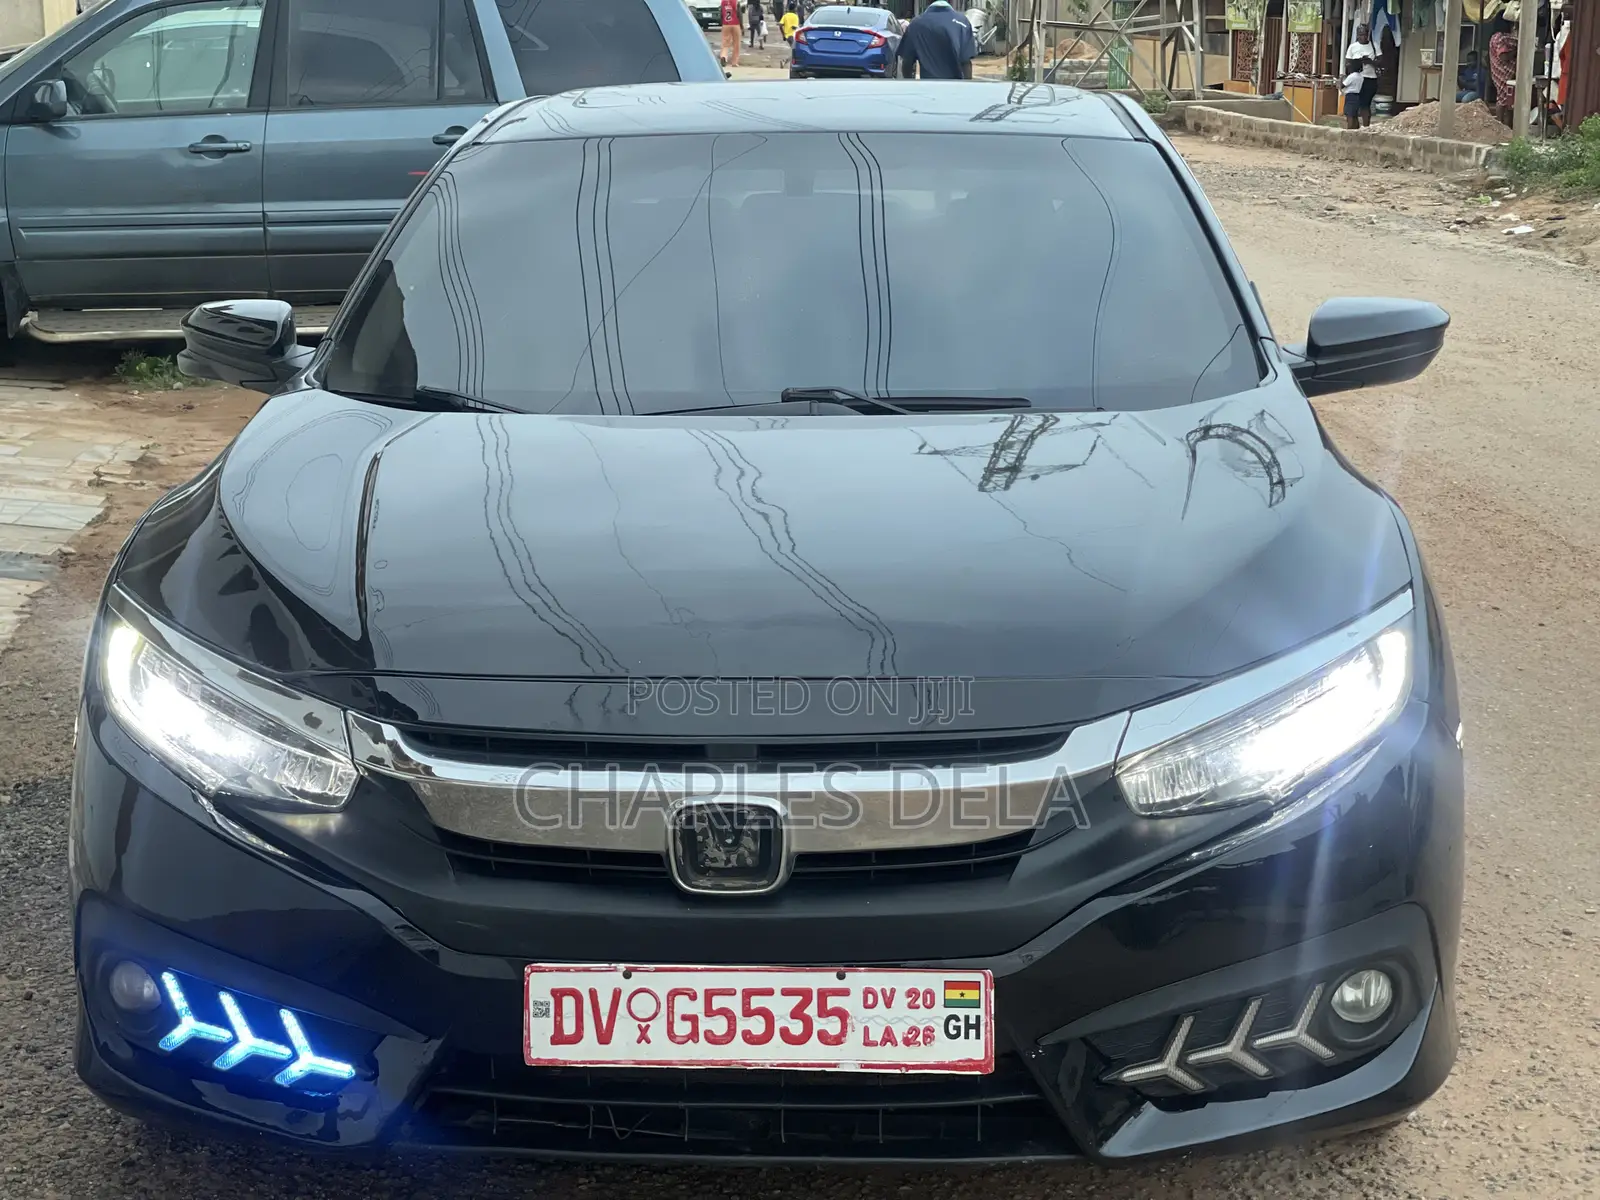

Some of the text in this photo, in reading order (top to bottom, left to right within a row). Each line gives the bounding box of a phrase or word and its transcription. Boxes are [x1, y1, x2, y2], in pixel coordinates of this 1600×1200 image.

[862, 986, 936, 1010] DV 20
[862, 1025, 898, 1047] LA
[943, 1013, 981, 1040] GH
